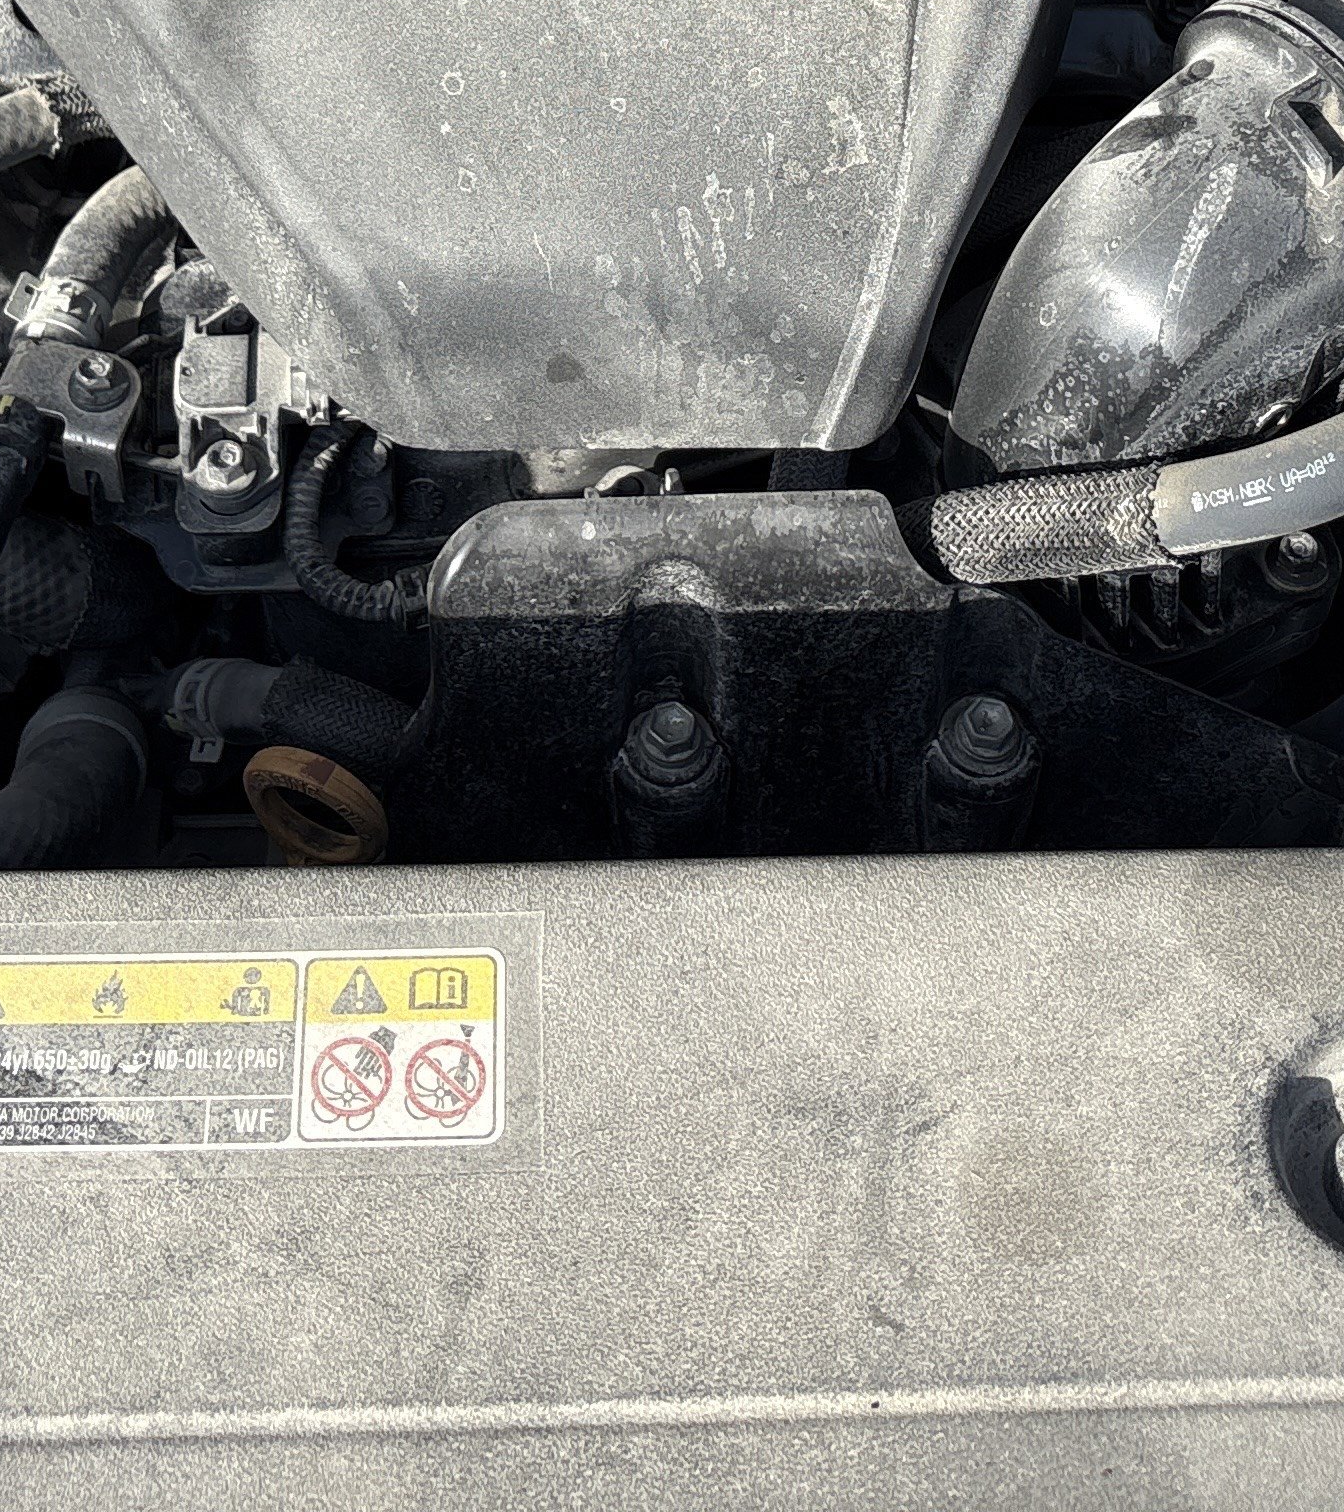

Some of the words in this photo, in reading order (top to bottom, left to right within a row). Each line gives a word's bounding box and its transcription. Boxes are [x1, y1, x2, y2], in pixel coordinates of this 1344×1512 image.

[237, 1046, 285, 1074] (PAG)
[11, 1106, 58, 1123] MOTOR
[62, 1105, 155, 1122] CORPORATION
[233, 1107, 276, 1134] WF
[16, 1124, 56, 1140] J2842
[57, 1124, 97, 1140] J2845
